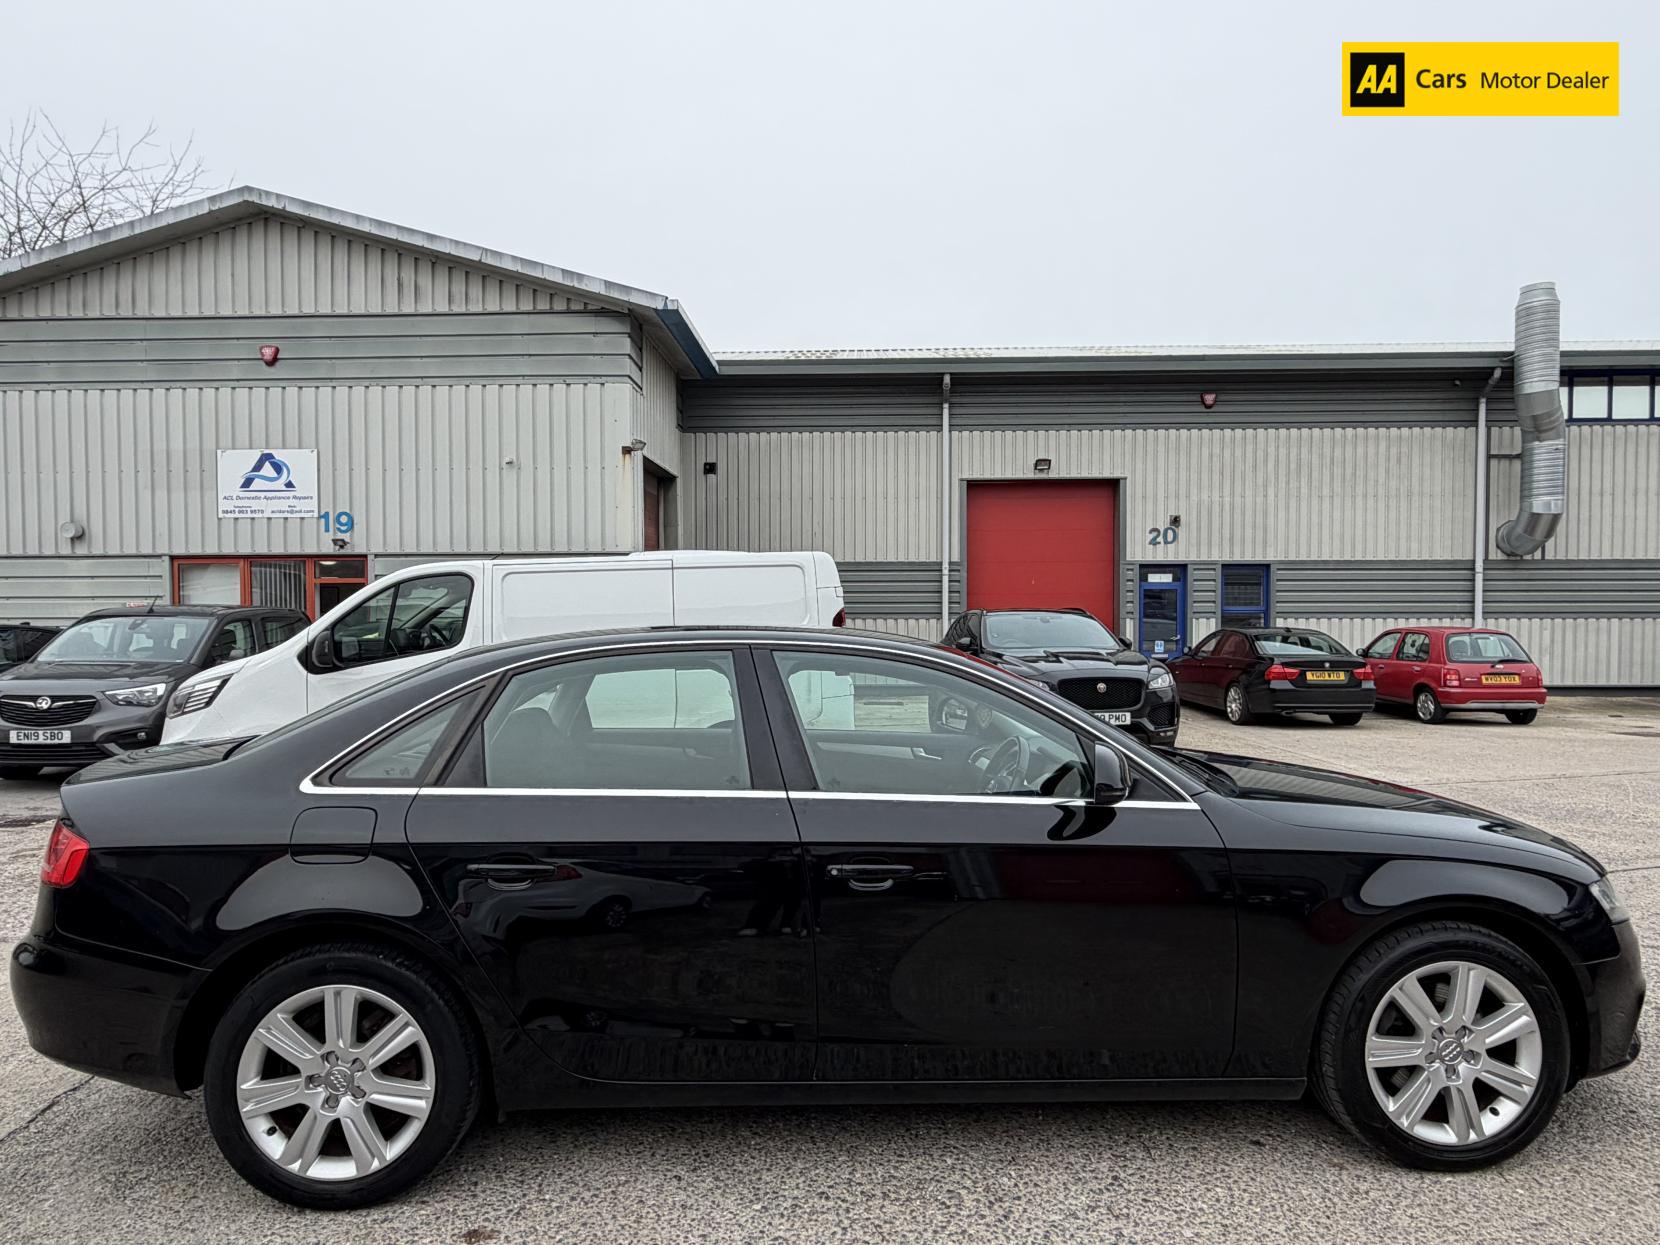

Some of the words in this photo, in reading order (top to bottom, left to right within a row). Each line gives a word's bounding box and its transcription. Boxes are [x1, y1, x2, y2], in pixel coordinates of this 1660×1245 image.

[320, 511, 354, 534] 19
[1148, 526, 1177, 545] 20
[1108, 713, 1127, 723] PMO
[16, 731, 40, 741] EN19
[42, 731, 63, 741] SBO
